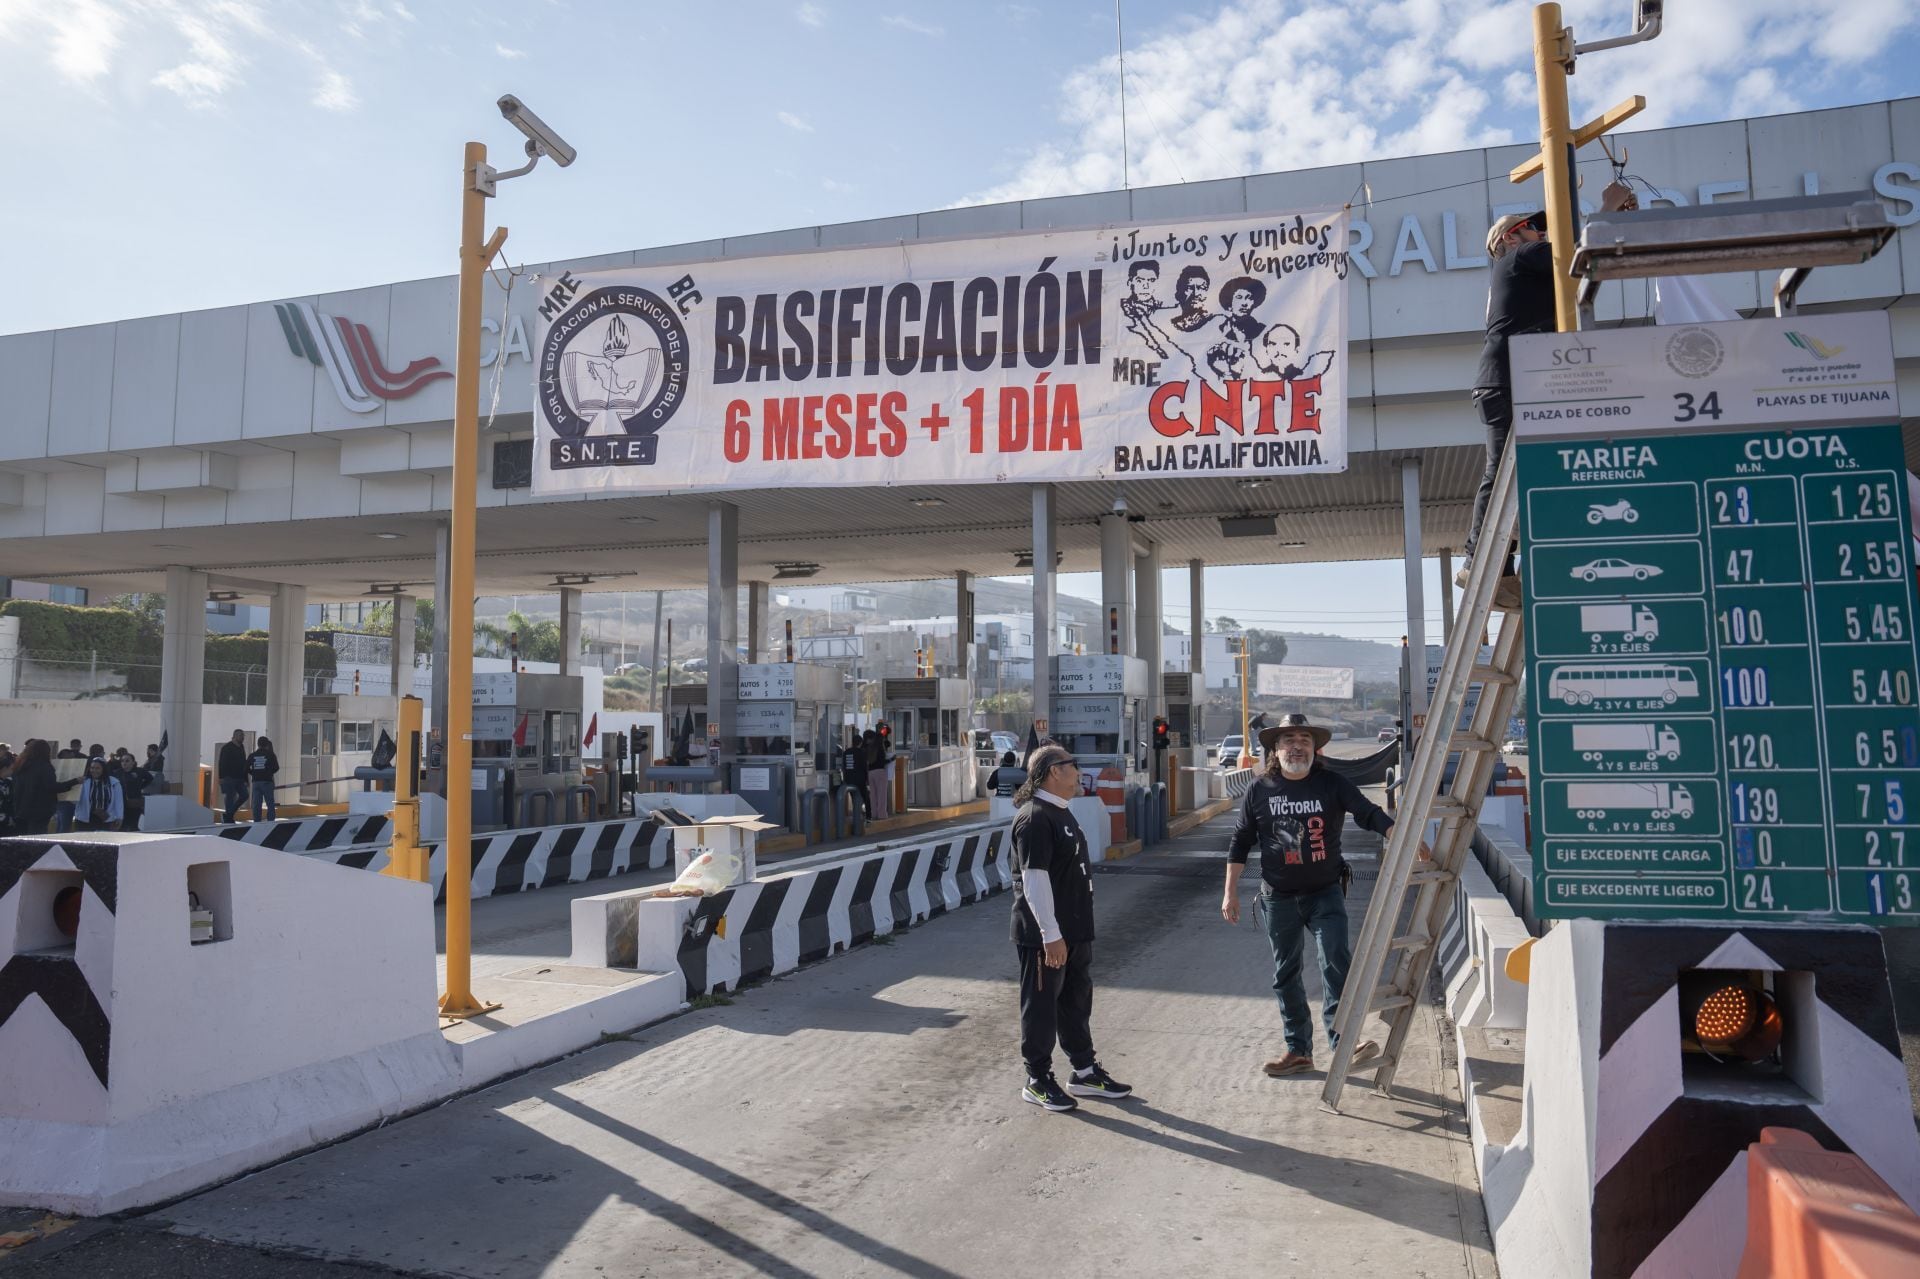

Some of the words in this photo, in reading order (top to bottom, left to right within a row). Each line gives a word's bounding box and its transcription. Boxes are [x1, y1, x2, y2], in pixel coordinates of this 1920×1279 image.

[1219, 231, 1238, 262] y
[1249, 214, 1332, 252] unidos
[1240, 248, 1350, 281] Venceremos
[538, 270, 583, 323] MRE
[600, 294, 616, 308] AL
[617, 293, 672, 332] SERVICIO
[713, 256, 1104, 385] BASIFICACIÓN
[547, 300, 599, 372] EDUCACION
[666, 329, 681, 359] DEL
[1551, 346, 1597, 366] SCT
[546, 374, 555, 394] LA
[1112, 357, 1162, 388] MRE
[652, 362, 682, 419] PUEBLO
[1756, 395, 1807, 408] PLAYAS
[1810, 394, 1828, 405] DE
[1831, 390, 1890, 405] TIJUANA
[549, 393, 567, 424] POR
[723, 399, 752, 464] 6
[762, 391, 908, 462] MESES
[920, 403, 950, 442] +
[962, 387, 986, 455] 1
[998, 371, 1084, 454] DÍA
[1148, 374, 1323, 438] CNTE
[1522, 410, 1563, 421] PLAZA
[1566, 408, 1582, 418] DE
[1586, 405, 1632, 418] COBRO
[1673, 391, 1723, 423] 34
[1113, 445, 1176, 473] BAJA
[1558, 446, 1658, 470] TARIFA
[1744, 435, 1848, 461] CUOTA
[1571, 469, 1645, 482] REFERENCIA
[1736, 462, 1765, 473] M.N.
[1835, 458, 1860, 469] U.S.
[1831, 483, 1892, 520] 1.25
[1838, 541, 1902, 581] 2.55
[1846, 603, 1903, 643] 5.45
[1611, 644, 1618, 652] 3
[1621, 643, 1651, 652] EJES
[1853, 669, 1911, 706] 5.40
[1606, 701, 1613, 709] 3
[1624, 700, 1631, 709] 4
[1636, 700, 1665, 709] EJES
[1597, 762, 1604, 770] 4
[1616, 761, 1624, 769] 5
[1629, 761, 1659, 770] EJES
[1269, 800, 1323, 815] VICTORIA
[1308, 816, 1326, 862] CNTE
[1613, 823, 1621, 831] 8
[1632, 822, 1640, 831] 9
[1646, 822, 1675, 831] EJES
[1556, 849, 1577, 861] EJE
[1581, 849, 1658, 860] EXCEDENTE
[1663, 849, 1711, 861] CARGA
[1557, 884, 1577, 897] EJE
[1581, 884, 1659, 896] EXCEDENTE
[1664, 885, 1715, 897] LIGERO
